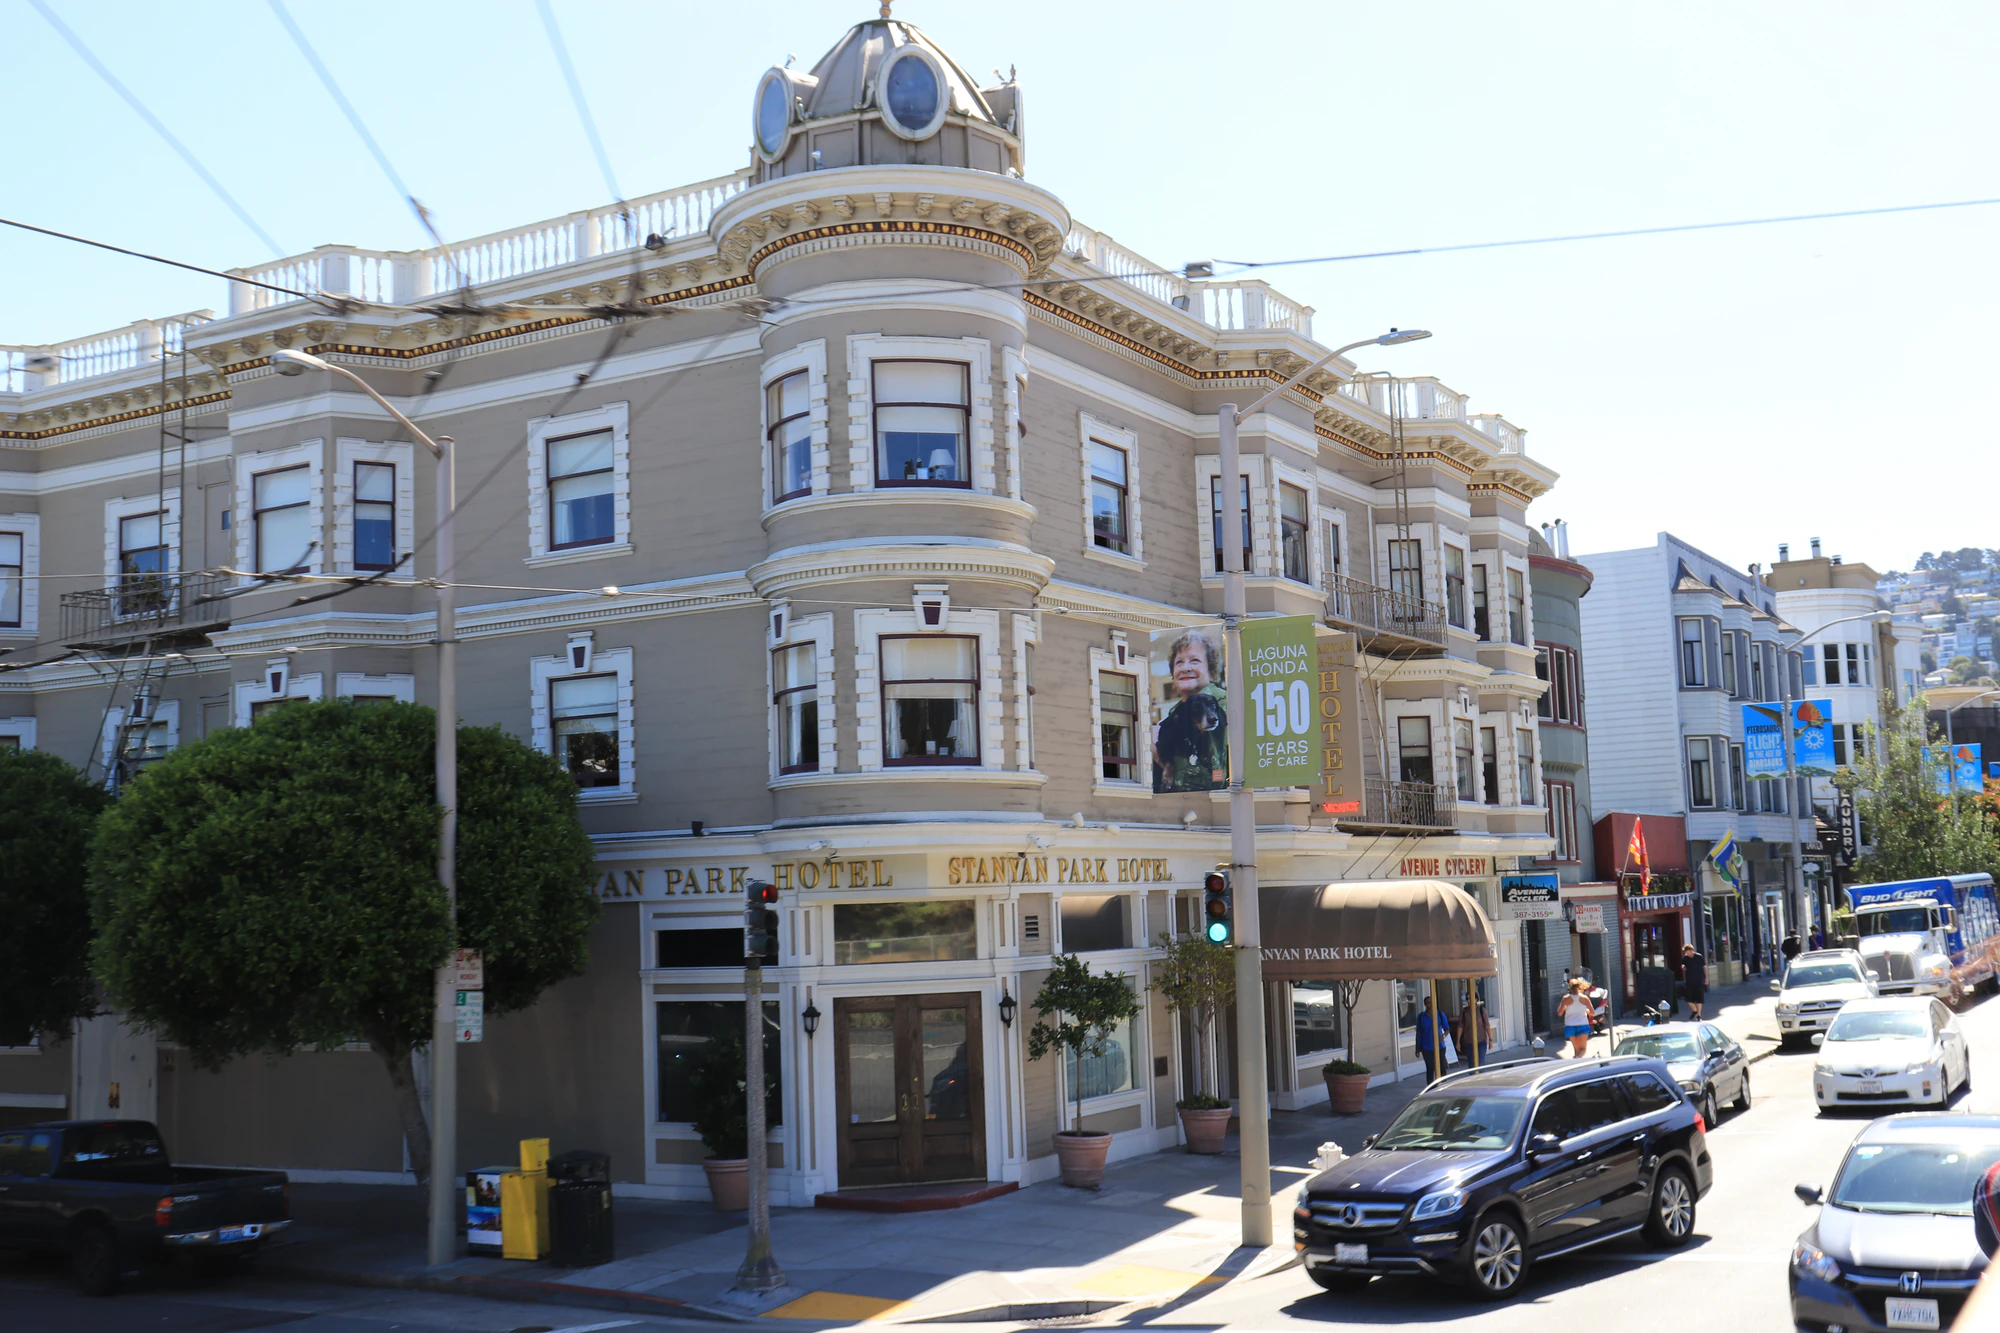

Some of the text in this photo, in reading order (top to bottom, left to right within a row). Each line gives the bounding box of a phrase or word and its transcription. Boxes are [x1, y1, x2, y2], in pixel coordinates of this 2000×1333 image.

[1249, 644, 1308, 663] LAGUNA
[1250, 659, 1308, 677] HONDA
[1251, 679, 1310, 737] 150
[1318, 670, 1343, 796] HOTEL
[1746, 724, 1781, 734] PTEROSAURS
[1256, 739, 1309, 757] YEARS
[1747, 733, 1781, 751] FLIGHT
[1258, 755, 1308, 768] OF CARE
[1748, 749, 1782, 759] IN THE AGE OF
[1749, 758, 1783, 768] DINOSAURS
[1840, 789, 1854, 856] LAUNDRY
[948, 856, 1172, 885] STANYAN PARK HOTEL
[1400, 857, 1487, 876] AVENUE CYCLERY
[664, 866, 749, 895] PARK
[771, 859, 893, 890] HOTEL
[1508, 888, 1549, 896] AVENUE
[1860, 888, 1938, 904] BUD LIGHT
[1304, 947, 1340, 960] PARK
[1344, 946, 1392, 959] HOTEL
